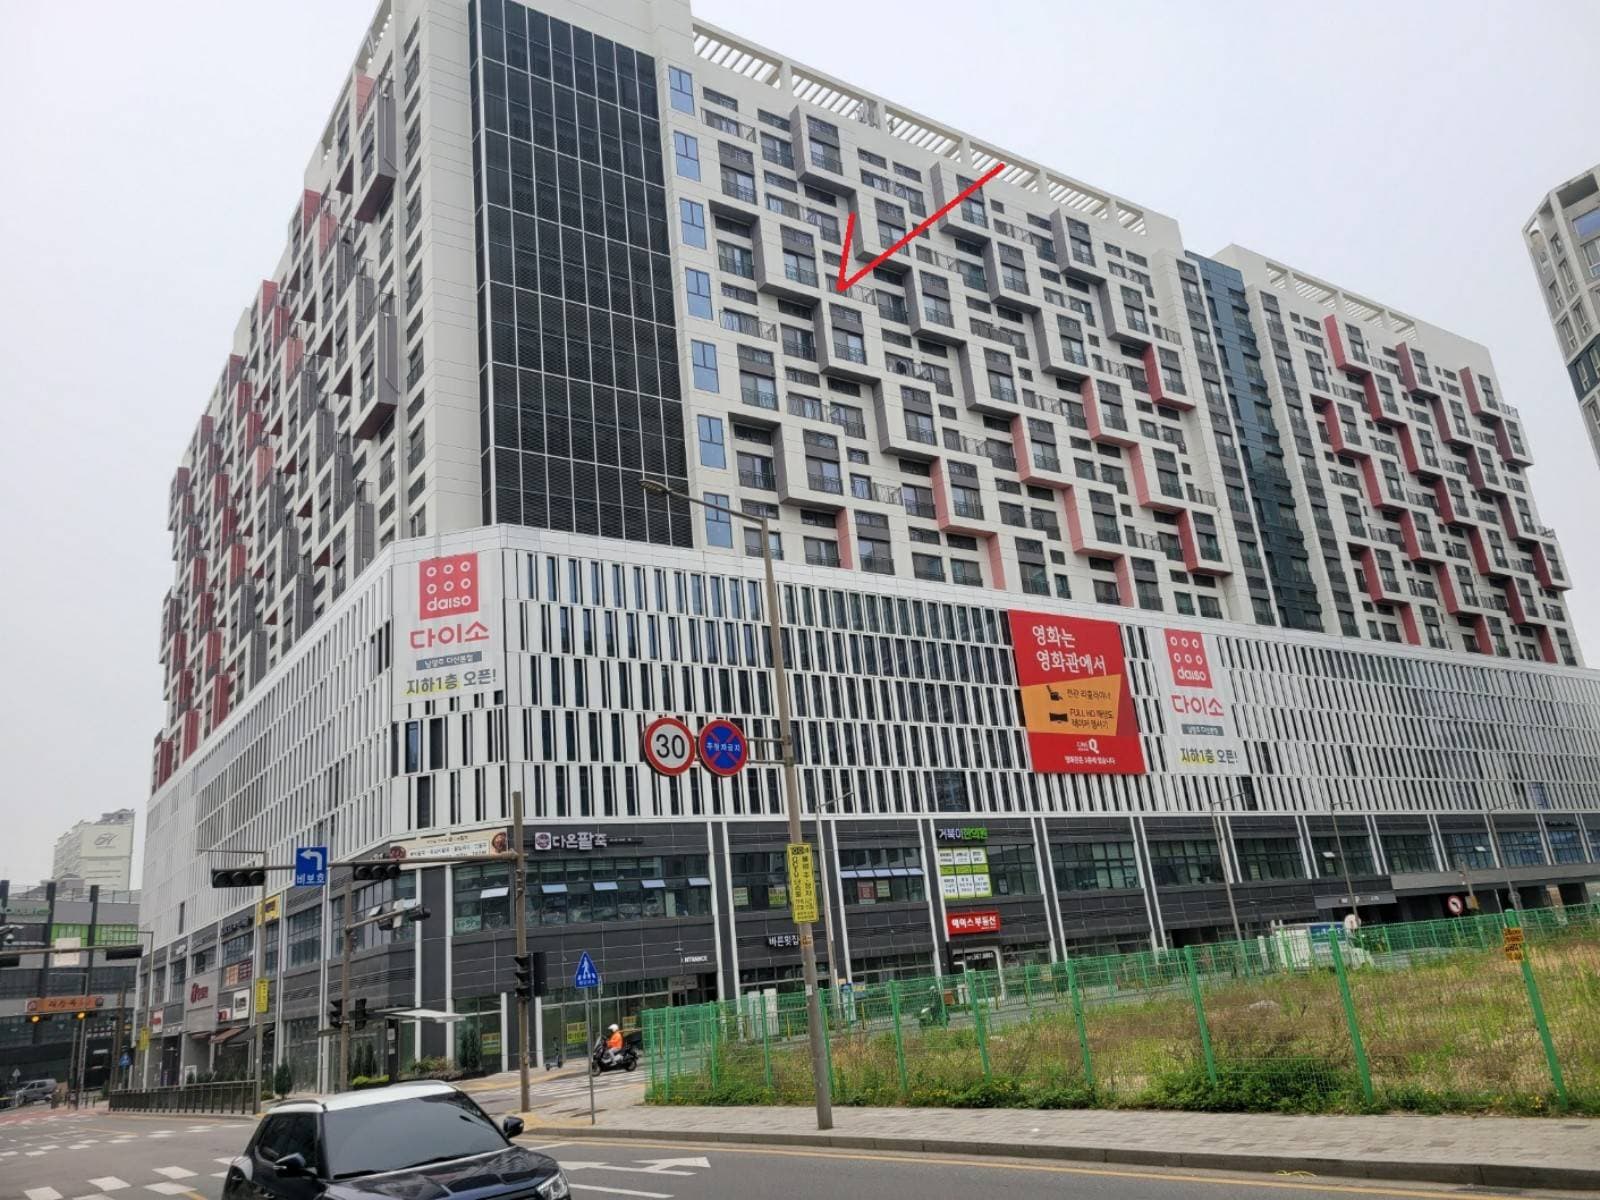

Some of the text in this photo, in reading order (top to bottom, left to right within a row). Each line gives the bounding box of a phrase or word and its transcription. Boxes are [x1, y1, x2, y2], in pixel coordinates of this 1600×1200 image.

[427, 595, 471, 611] daiso
[410, 621, 489, 649] 다이소
[1032, 625, 1076, 648] 영화는
[1036, 650, 1107, 676] 영화관에서
[1177, 666, 1206, 681] daiso
[406, 669, 496, 694] 지하1층 오픈!
[1171, 695, 1224, 716] 다이소
[656, 734, 685, 759] 30
[706, 742, 741, 752] 주정차금지
[1180, 748, 1238, 764] 지하1층 오픈!
[297, 873, 325, 885] 비보호
